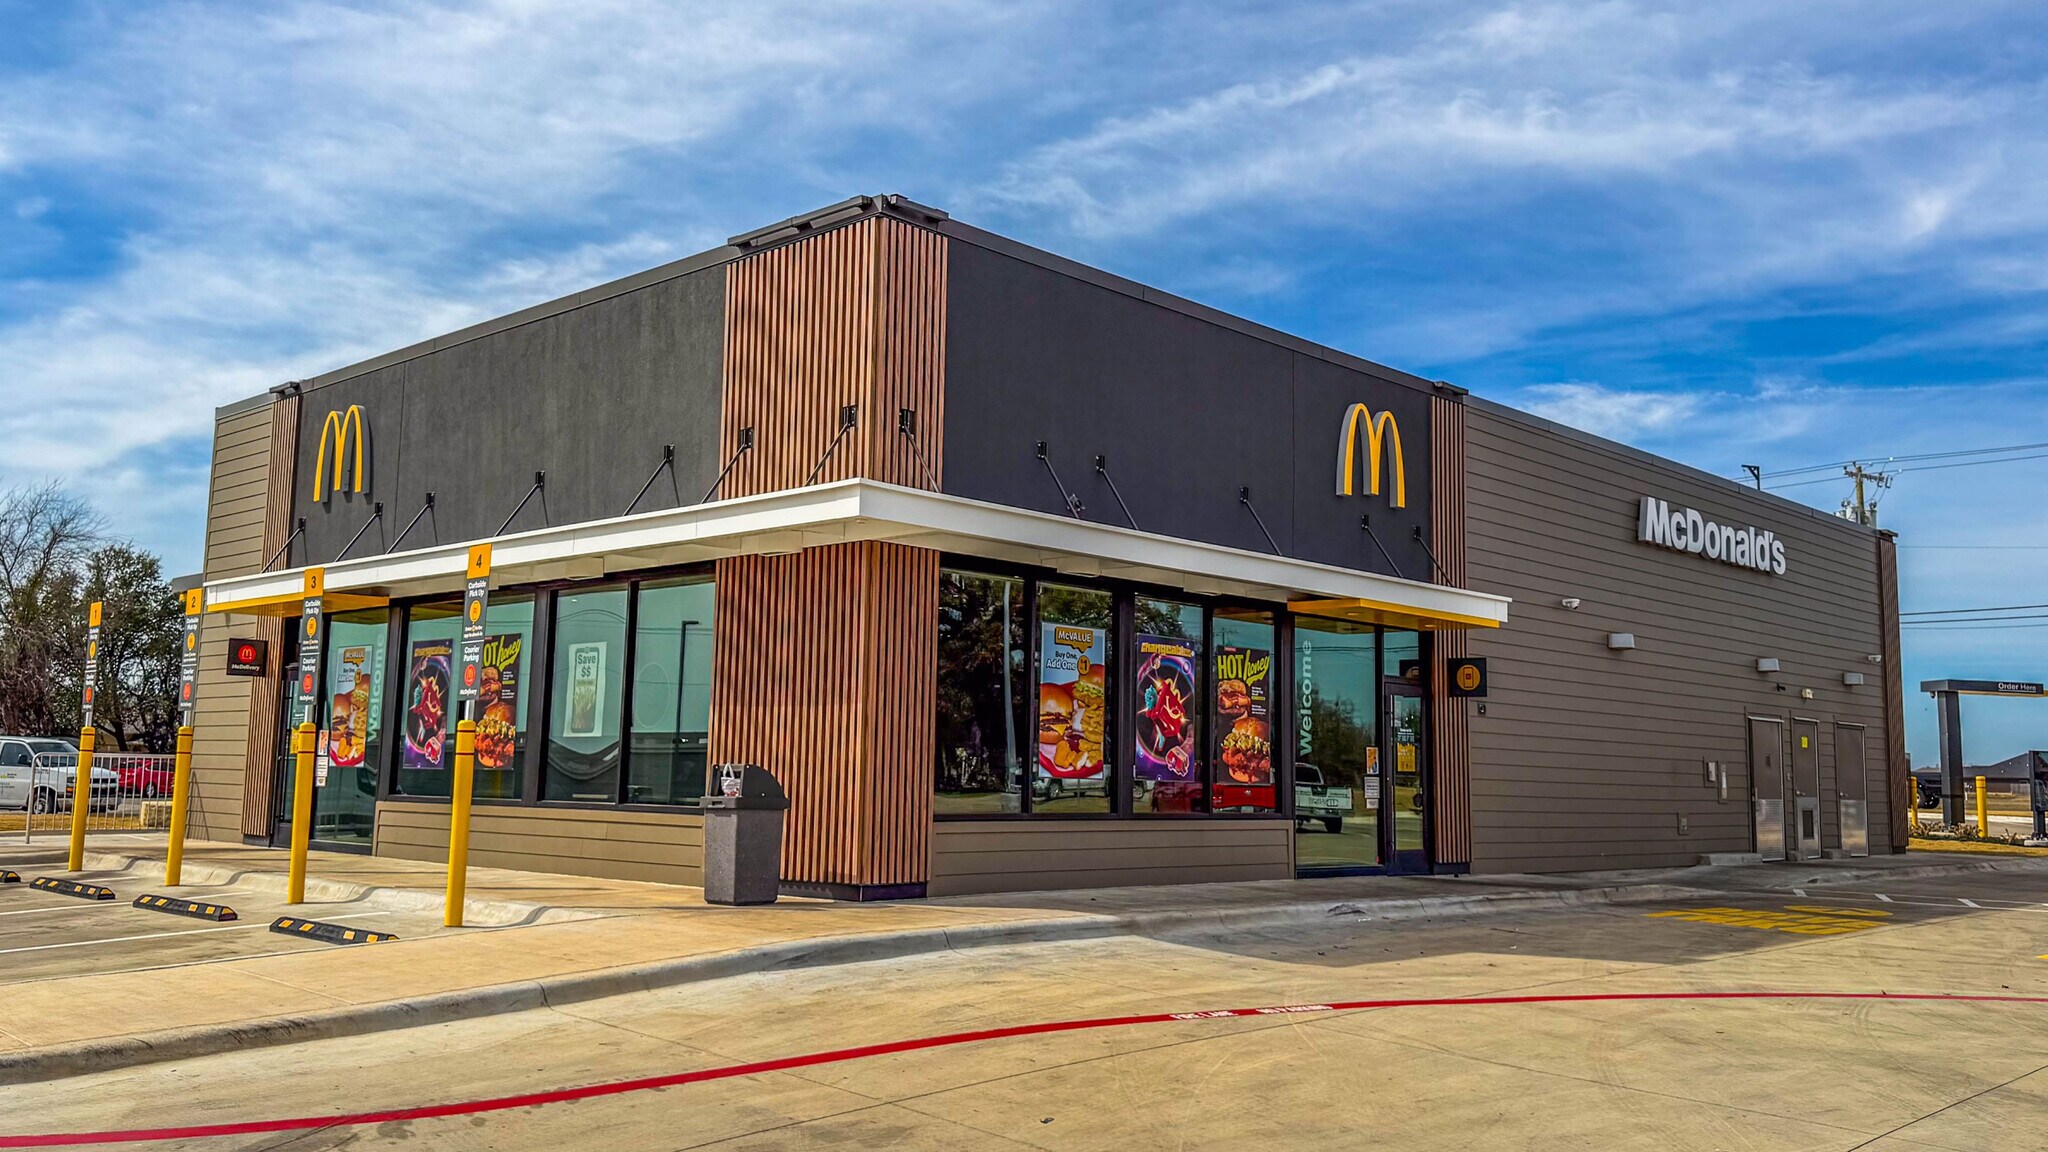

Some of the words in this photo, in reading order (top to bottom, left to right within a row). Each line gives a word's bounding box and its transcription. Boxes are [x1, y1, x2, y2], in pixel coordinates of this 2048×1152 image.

[1639, 497, 1786, 575] McDonald's
[476, 554, 482, 568] 4
[311, 576, 317, 589] 3
[468, 580, 487, 589] Curbside
[191, 596, 197, 608] 2
[1058, 630, 1092, 643] McVALUE
[464, 645, 480, 654] Courier
[483, 641, 499, 667] OT
[497, 635, 522, 672] honey
[1055, 651, 1065, 660] Buy
[303, 657, 316, 665] Courier
[463, 654, 480, 663] Parking
[577, 653, 597, 665] Save
[1046, 658, 1061, 669] Add
[1062, 659, 1077, 671] One
[302, 665, 316, 673] Parking
[581, 665, 592, 678] $$
[1217, 654, 1244, 680] HOT
[1243, 649, 1271, 687] honey
[367, 633, 385, 742] welcome
[1998, 682, 2019, 690] Order
[2020, 683, 2037, 691] Here
[1300, 640, 1313, 756] welcome
